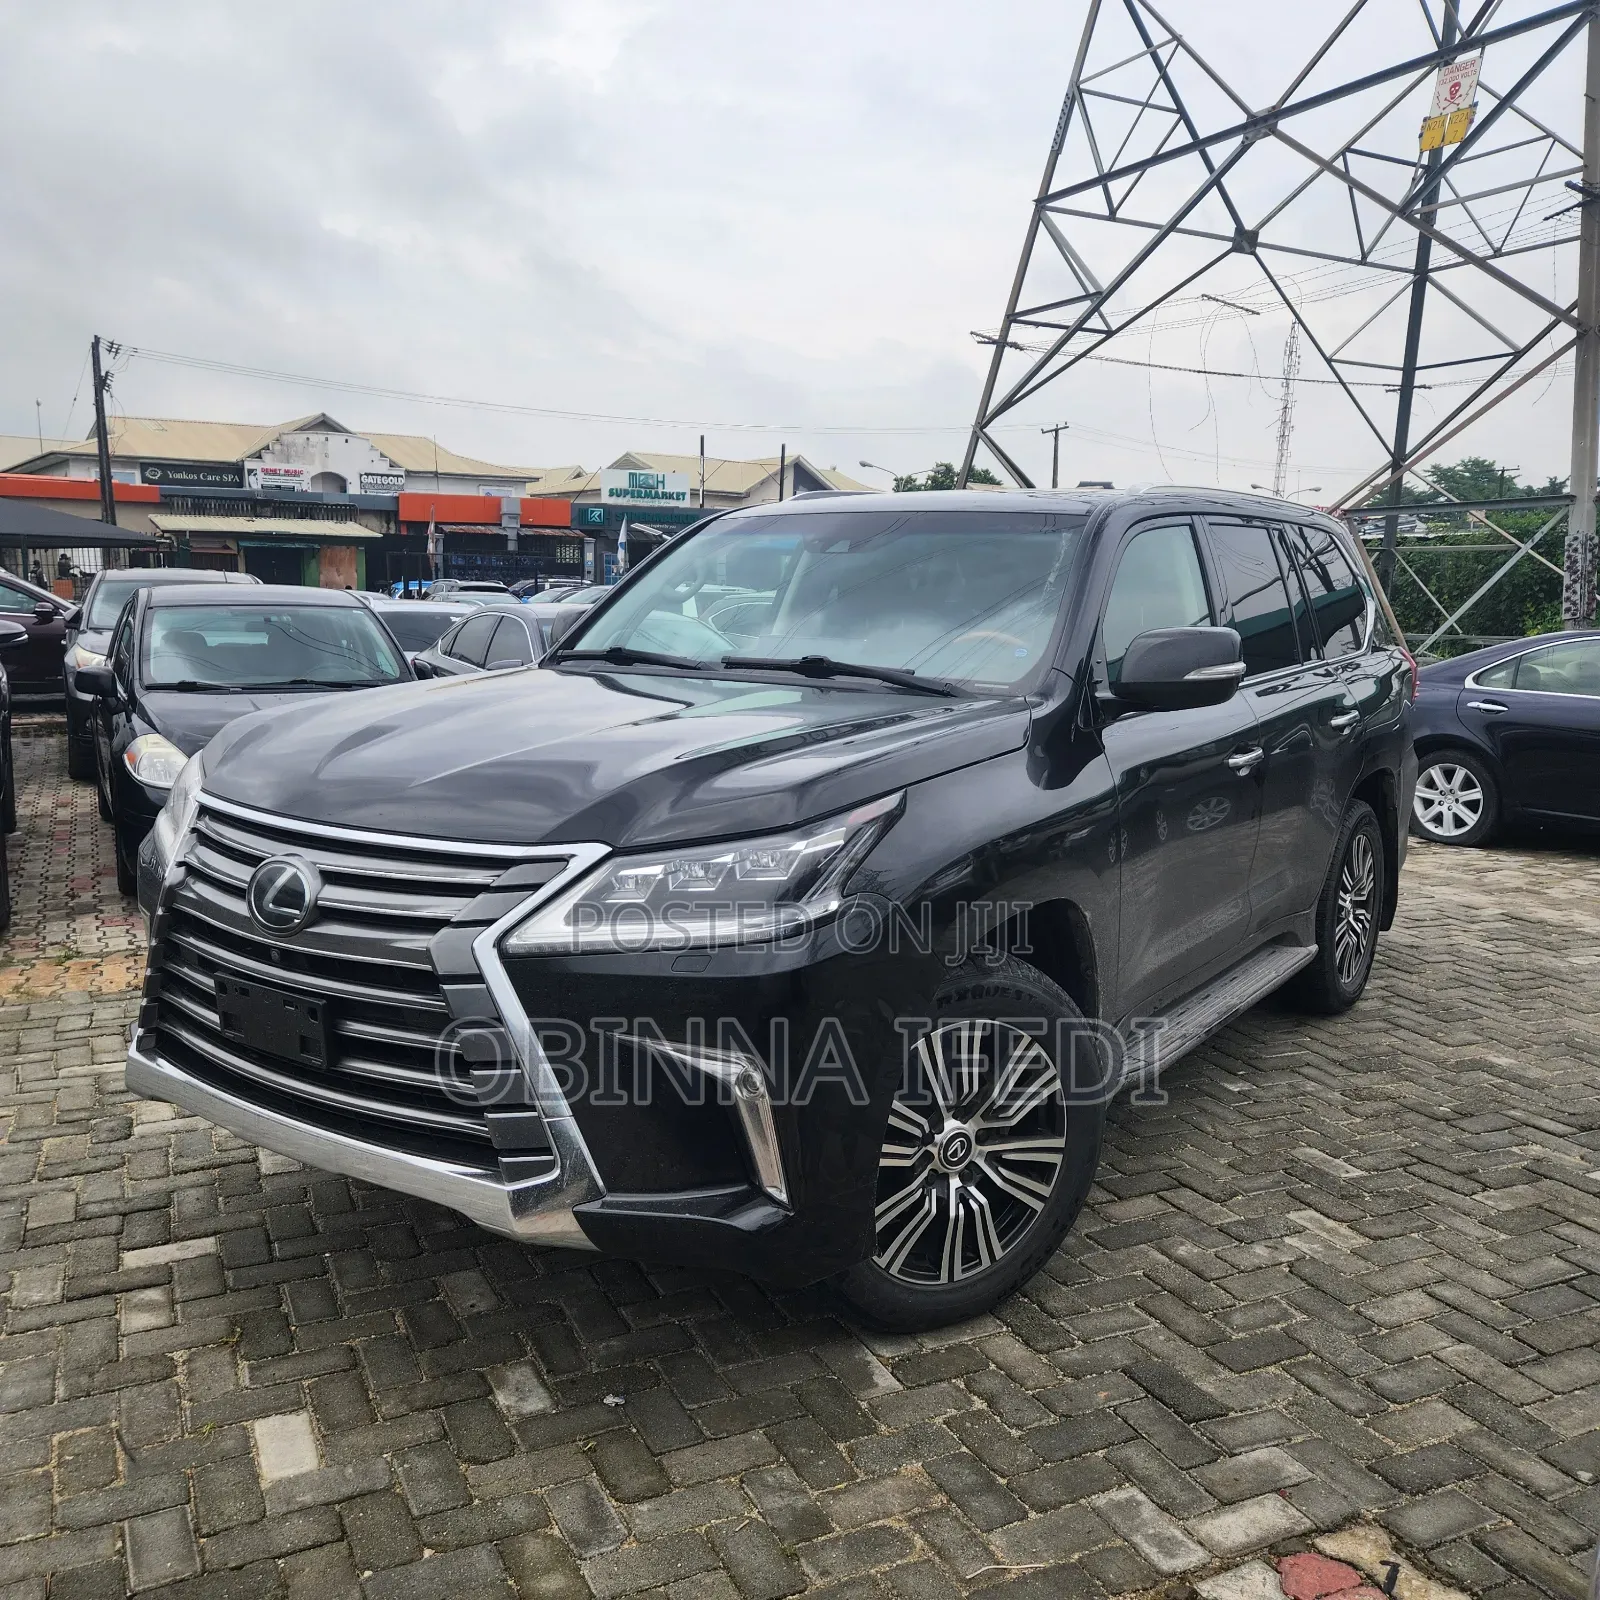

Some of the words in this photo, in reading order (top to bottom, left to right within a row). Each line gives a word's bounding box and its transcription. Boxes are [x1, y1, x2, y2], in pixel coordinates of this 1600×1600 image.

[1443, 59, 1476, 77] DANGER
[1460, 68, 1478, 79] VOLTS
[167, 470, 198, 480] Yonkos
[200, 472, 221, 482] Care
[222, 474, 240, 483] SPA
[360, 474, 405, 485] GATEGOLD
[608, 487, 687, 501] SUPERMARKET
